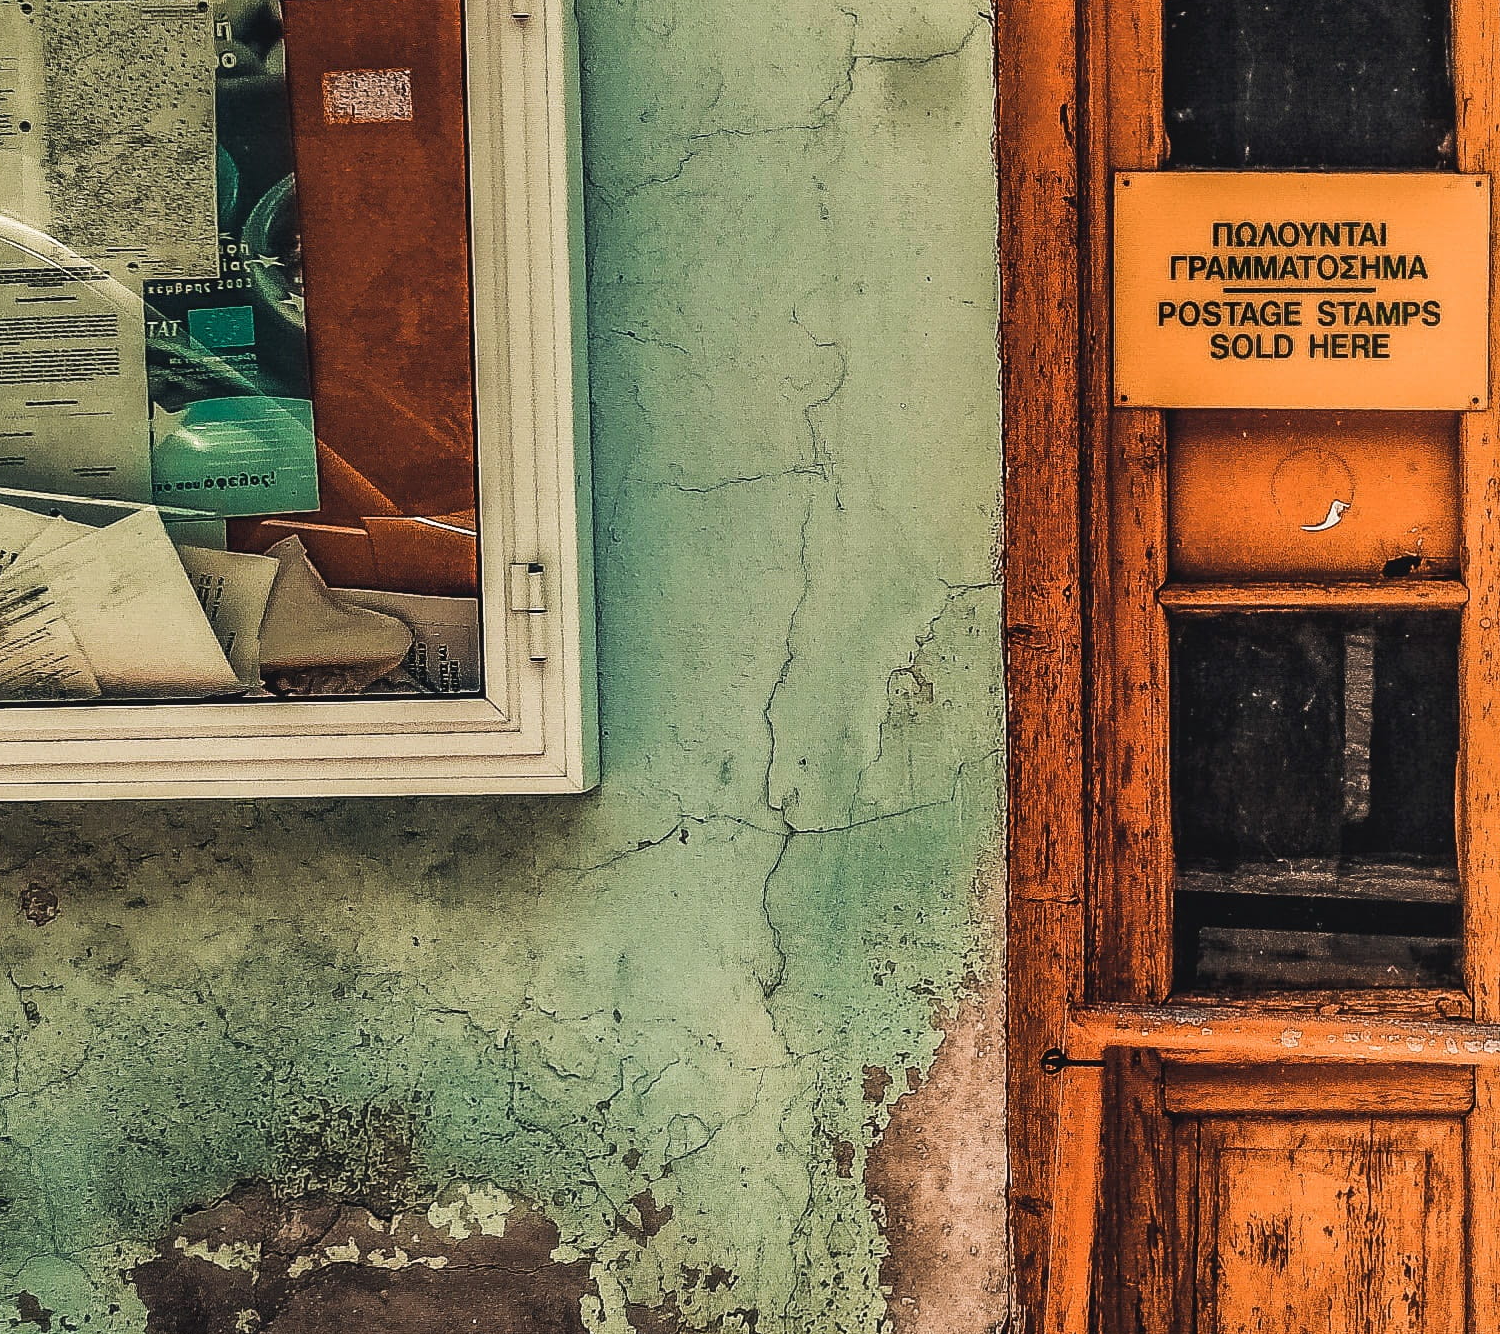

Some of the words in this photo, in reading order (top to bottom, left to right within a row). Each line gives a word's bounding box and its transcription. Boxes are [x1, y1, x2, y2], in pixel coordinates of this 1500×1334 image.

[1212, 221, 1387, 248] ΠΩΛΟΥΝΤΑΙ
[1170, 254, 1428, 281] ΓΡΑΜΜΑΤΟΣΗΜΑ
[147, 282, 211, 296] κέμβρης
[1158, 300, 1302, 327] POSTAGE
[1317, 300, 1441, 327] STAMPS
[1210, 333, 1294, 360] SOLD
[1309, 333, 1391, 359] HERE
